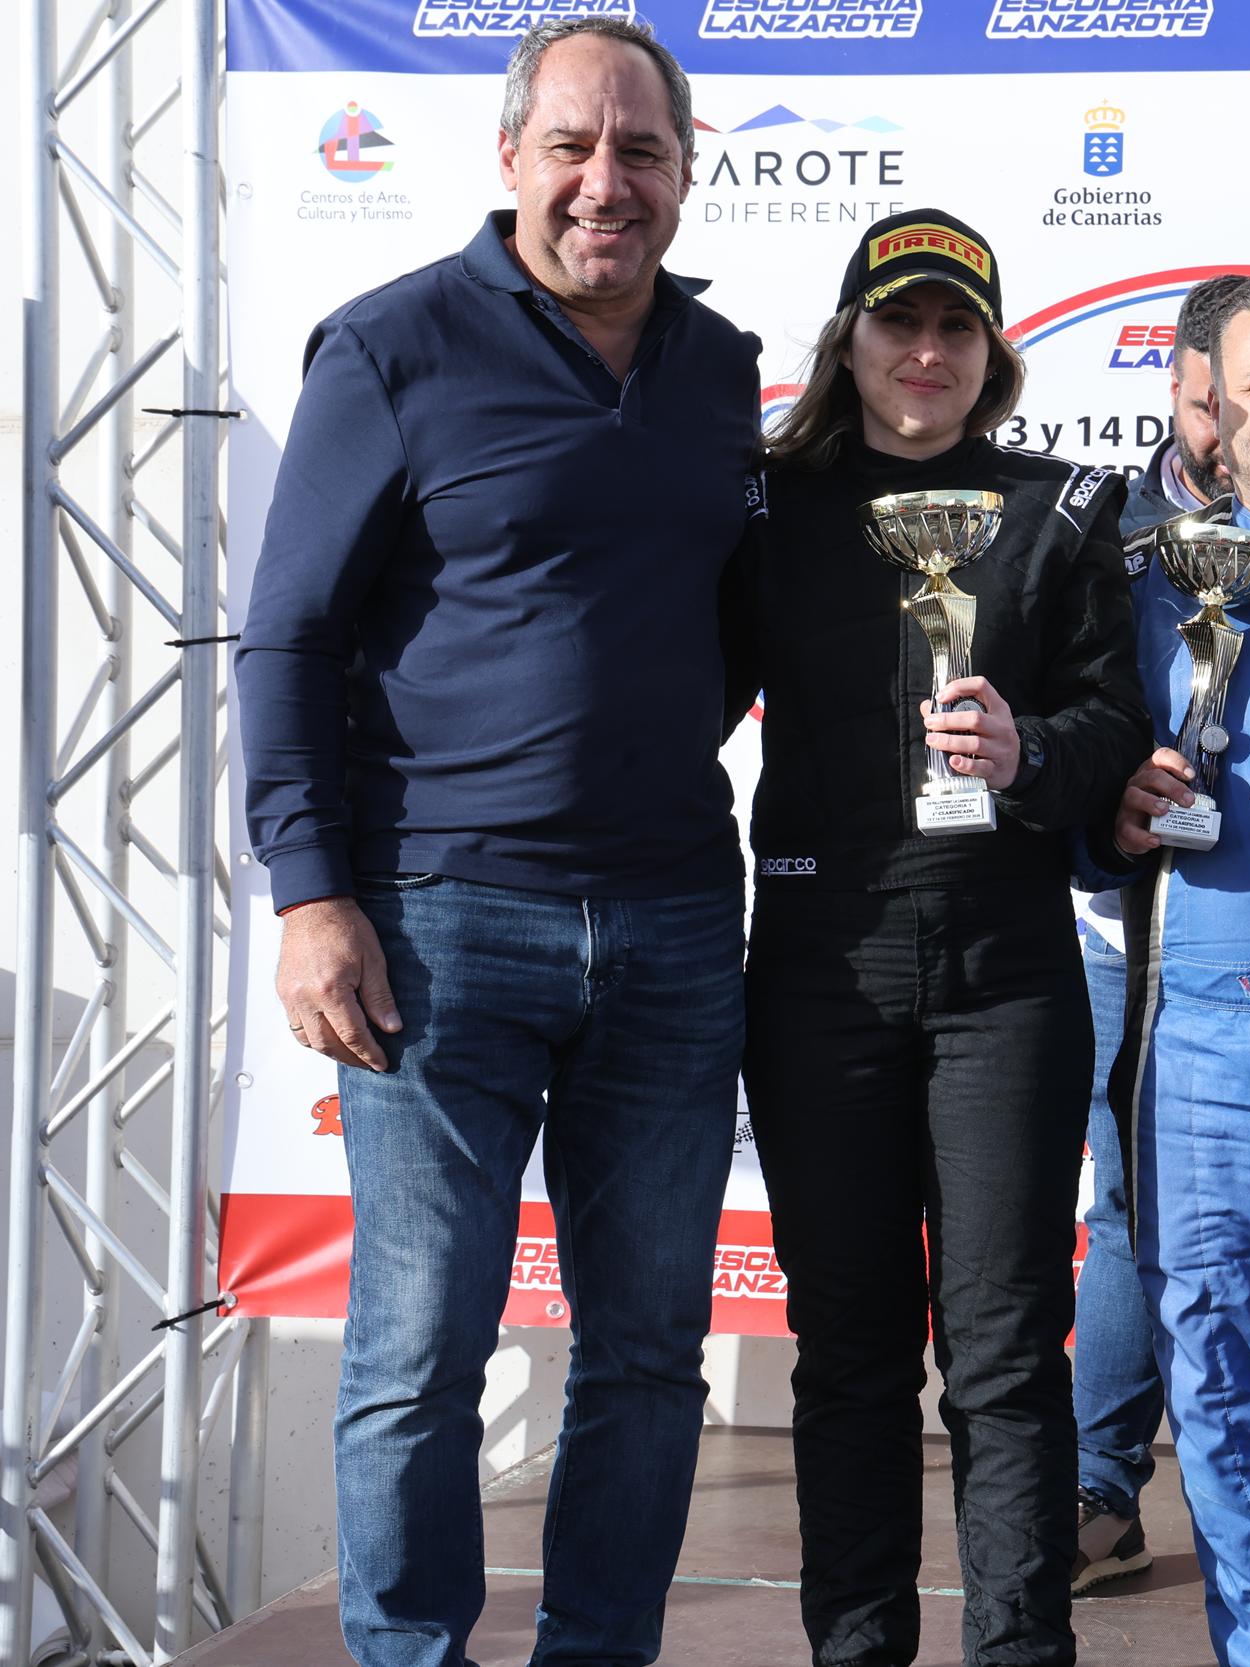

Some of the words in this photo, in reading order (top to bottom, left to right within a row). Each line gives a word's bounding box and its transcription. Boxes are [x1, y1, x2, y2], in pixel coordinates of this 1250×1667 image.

[418, 12, 629, 30] LANZA
[704, 13, 916, 32] LANZAROTE
[991, 13, 1207, 33] LANZAROTE
[691, 150, 905, 186] AROTE
[300, 190, 353, 203] Centros
[358, 191, 374, 204] de
[377, 191, 411, 204] Arte,
[1053, 187, 1152, 206] Gobierno
[297, 206, 346, 219] Cultura
[350, 211, 357, 223] y
[360, 206, 413, 219] Turismo
[705, 202, 904, 223] DIFERENTE
[1042, 209, 1067, 225] de
[1071, 208, 1163, 226] Canarias
[877, 228, 984, 271] PIRELLI
[1040, 423, 1064, 454] y
[1076, 416, 1124, 447] 14
[1135, 415, 1175, 447] D
[761, 857, 816, 877] sparco
